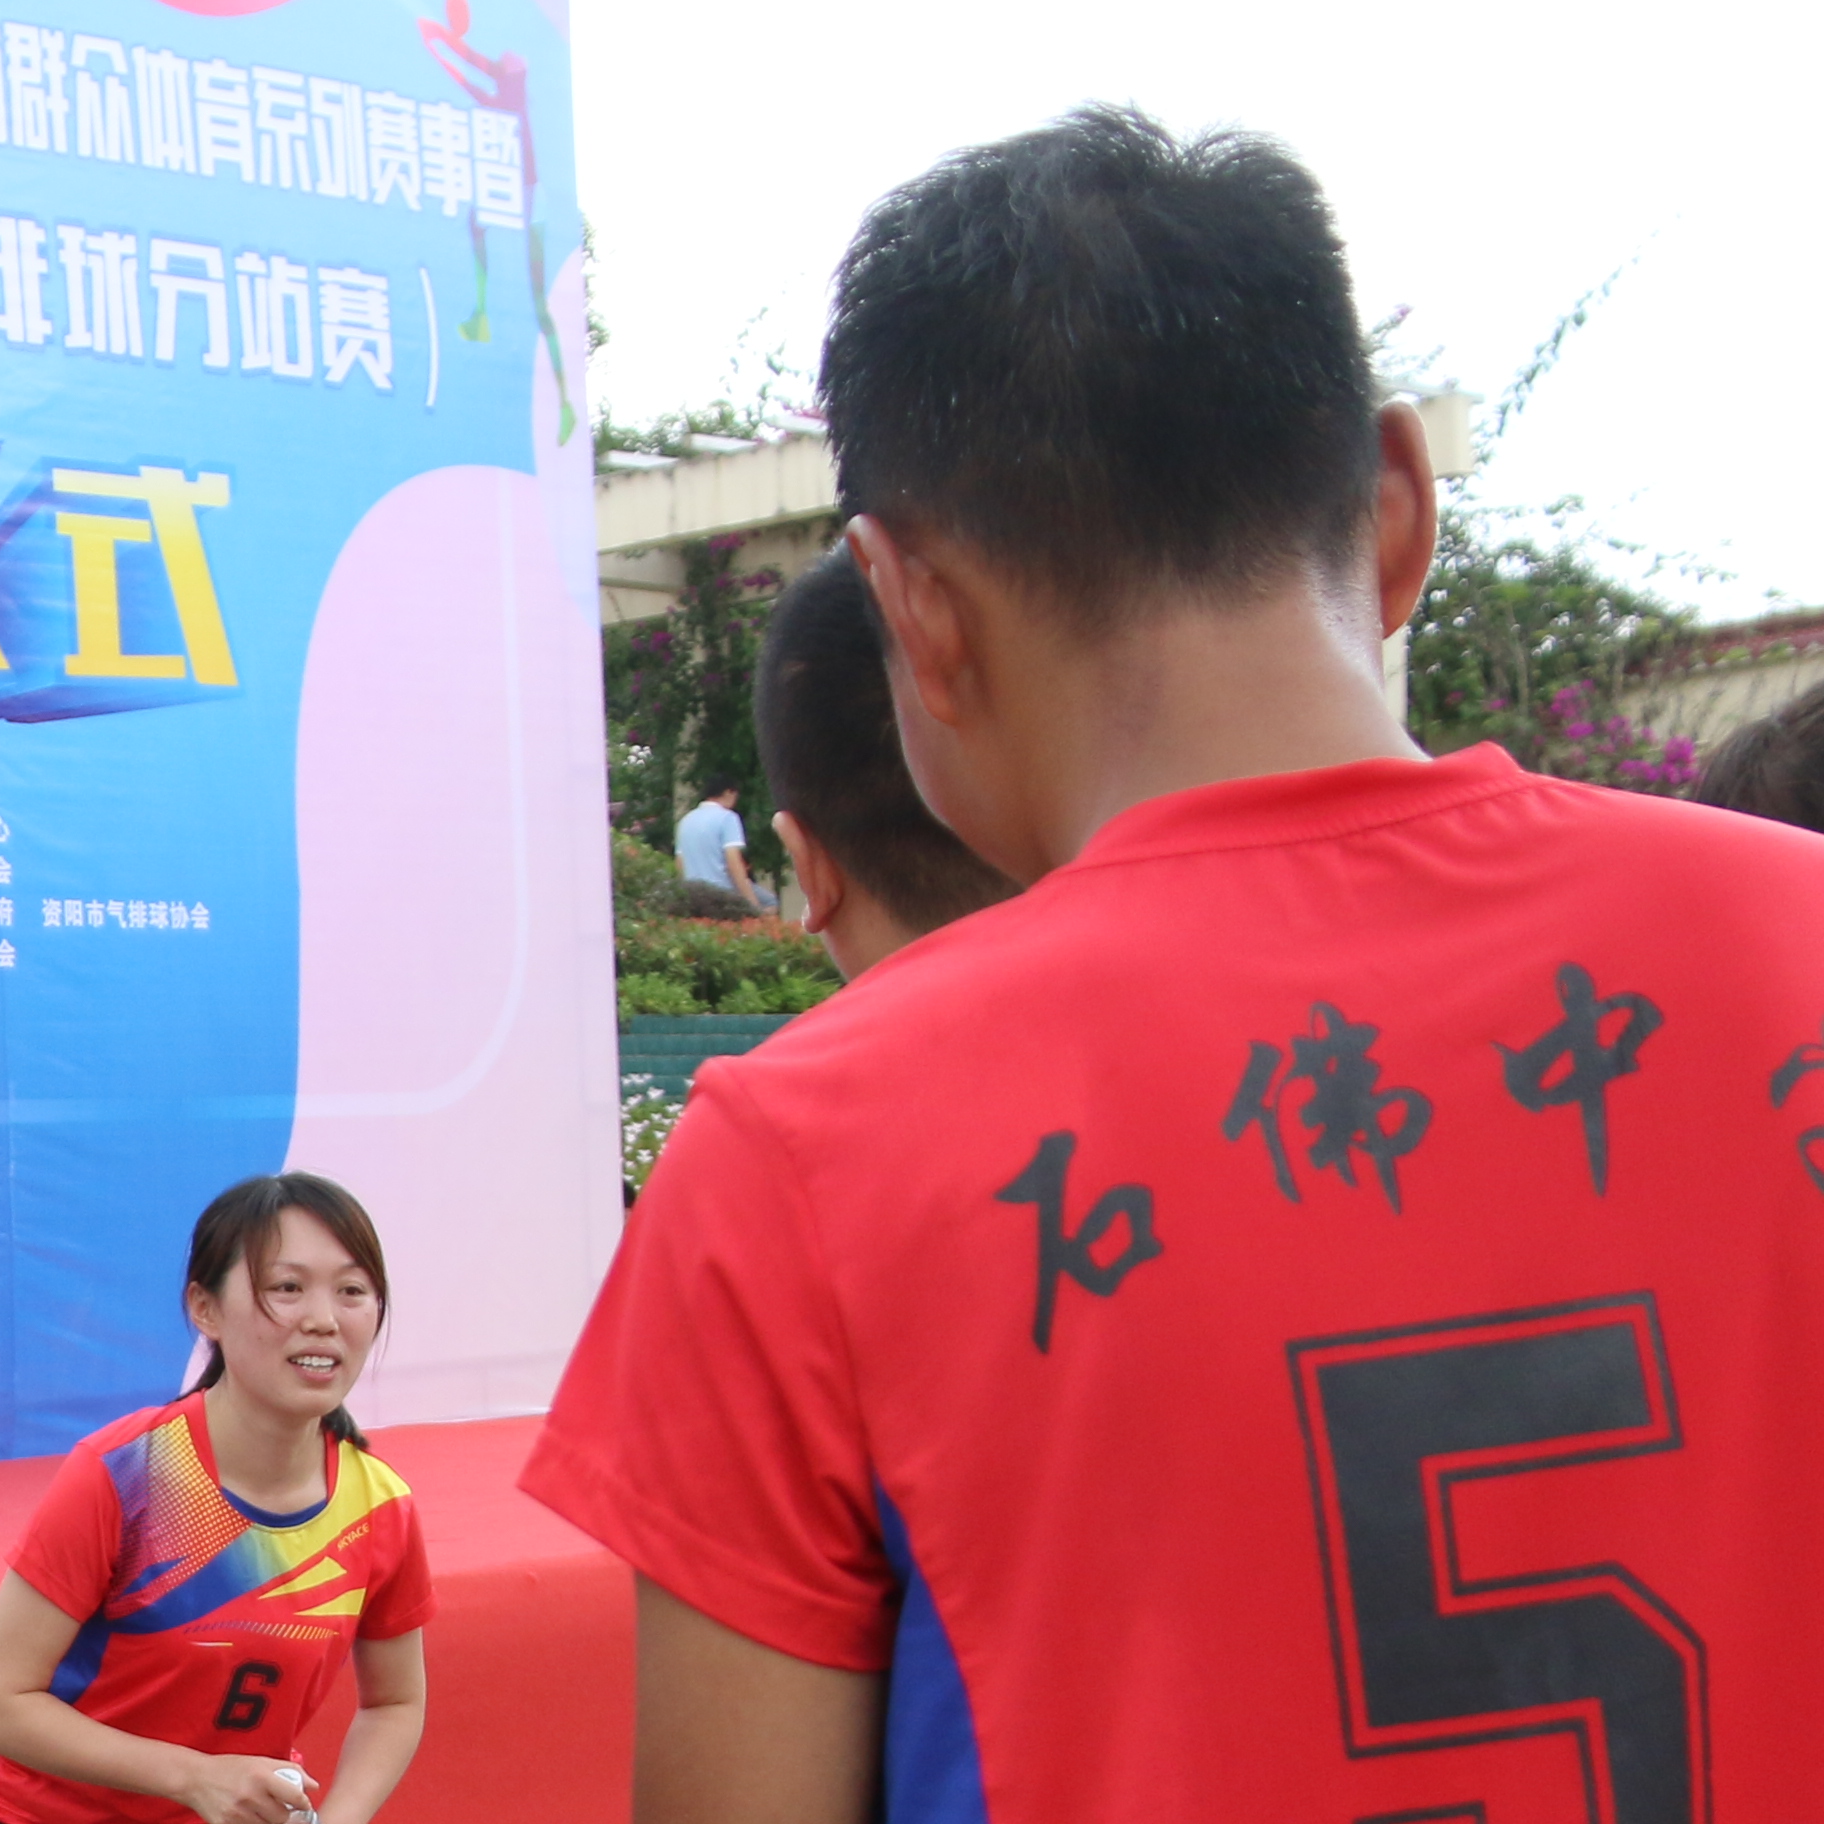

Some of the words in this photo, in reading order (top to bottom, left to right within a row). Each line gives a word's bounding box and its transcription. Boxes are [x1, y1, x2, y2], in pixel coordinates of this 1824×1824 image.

[41, 897, 210, 930] 资阳市气排球协会
[213, 1660, 281, 1732] 6
